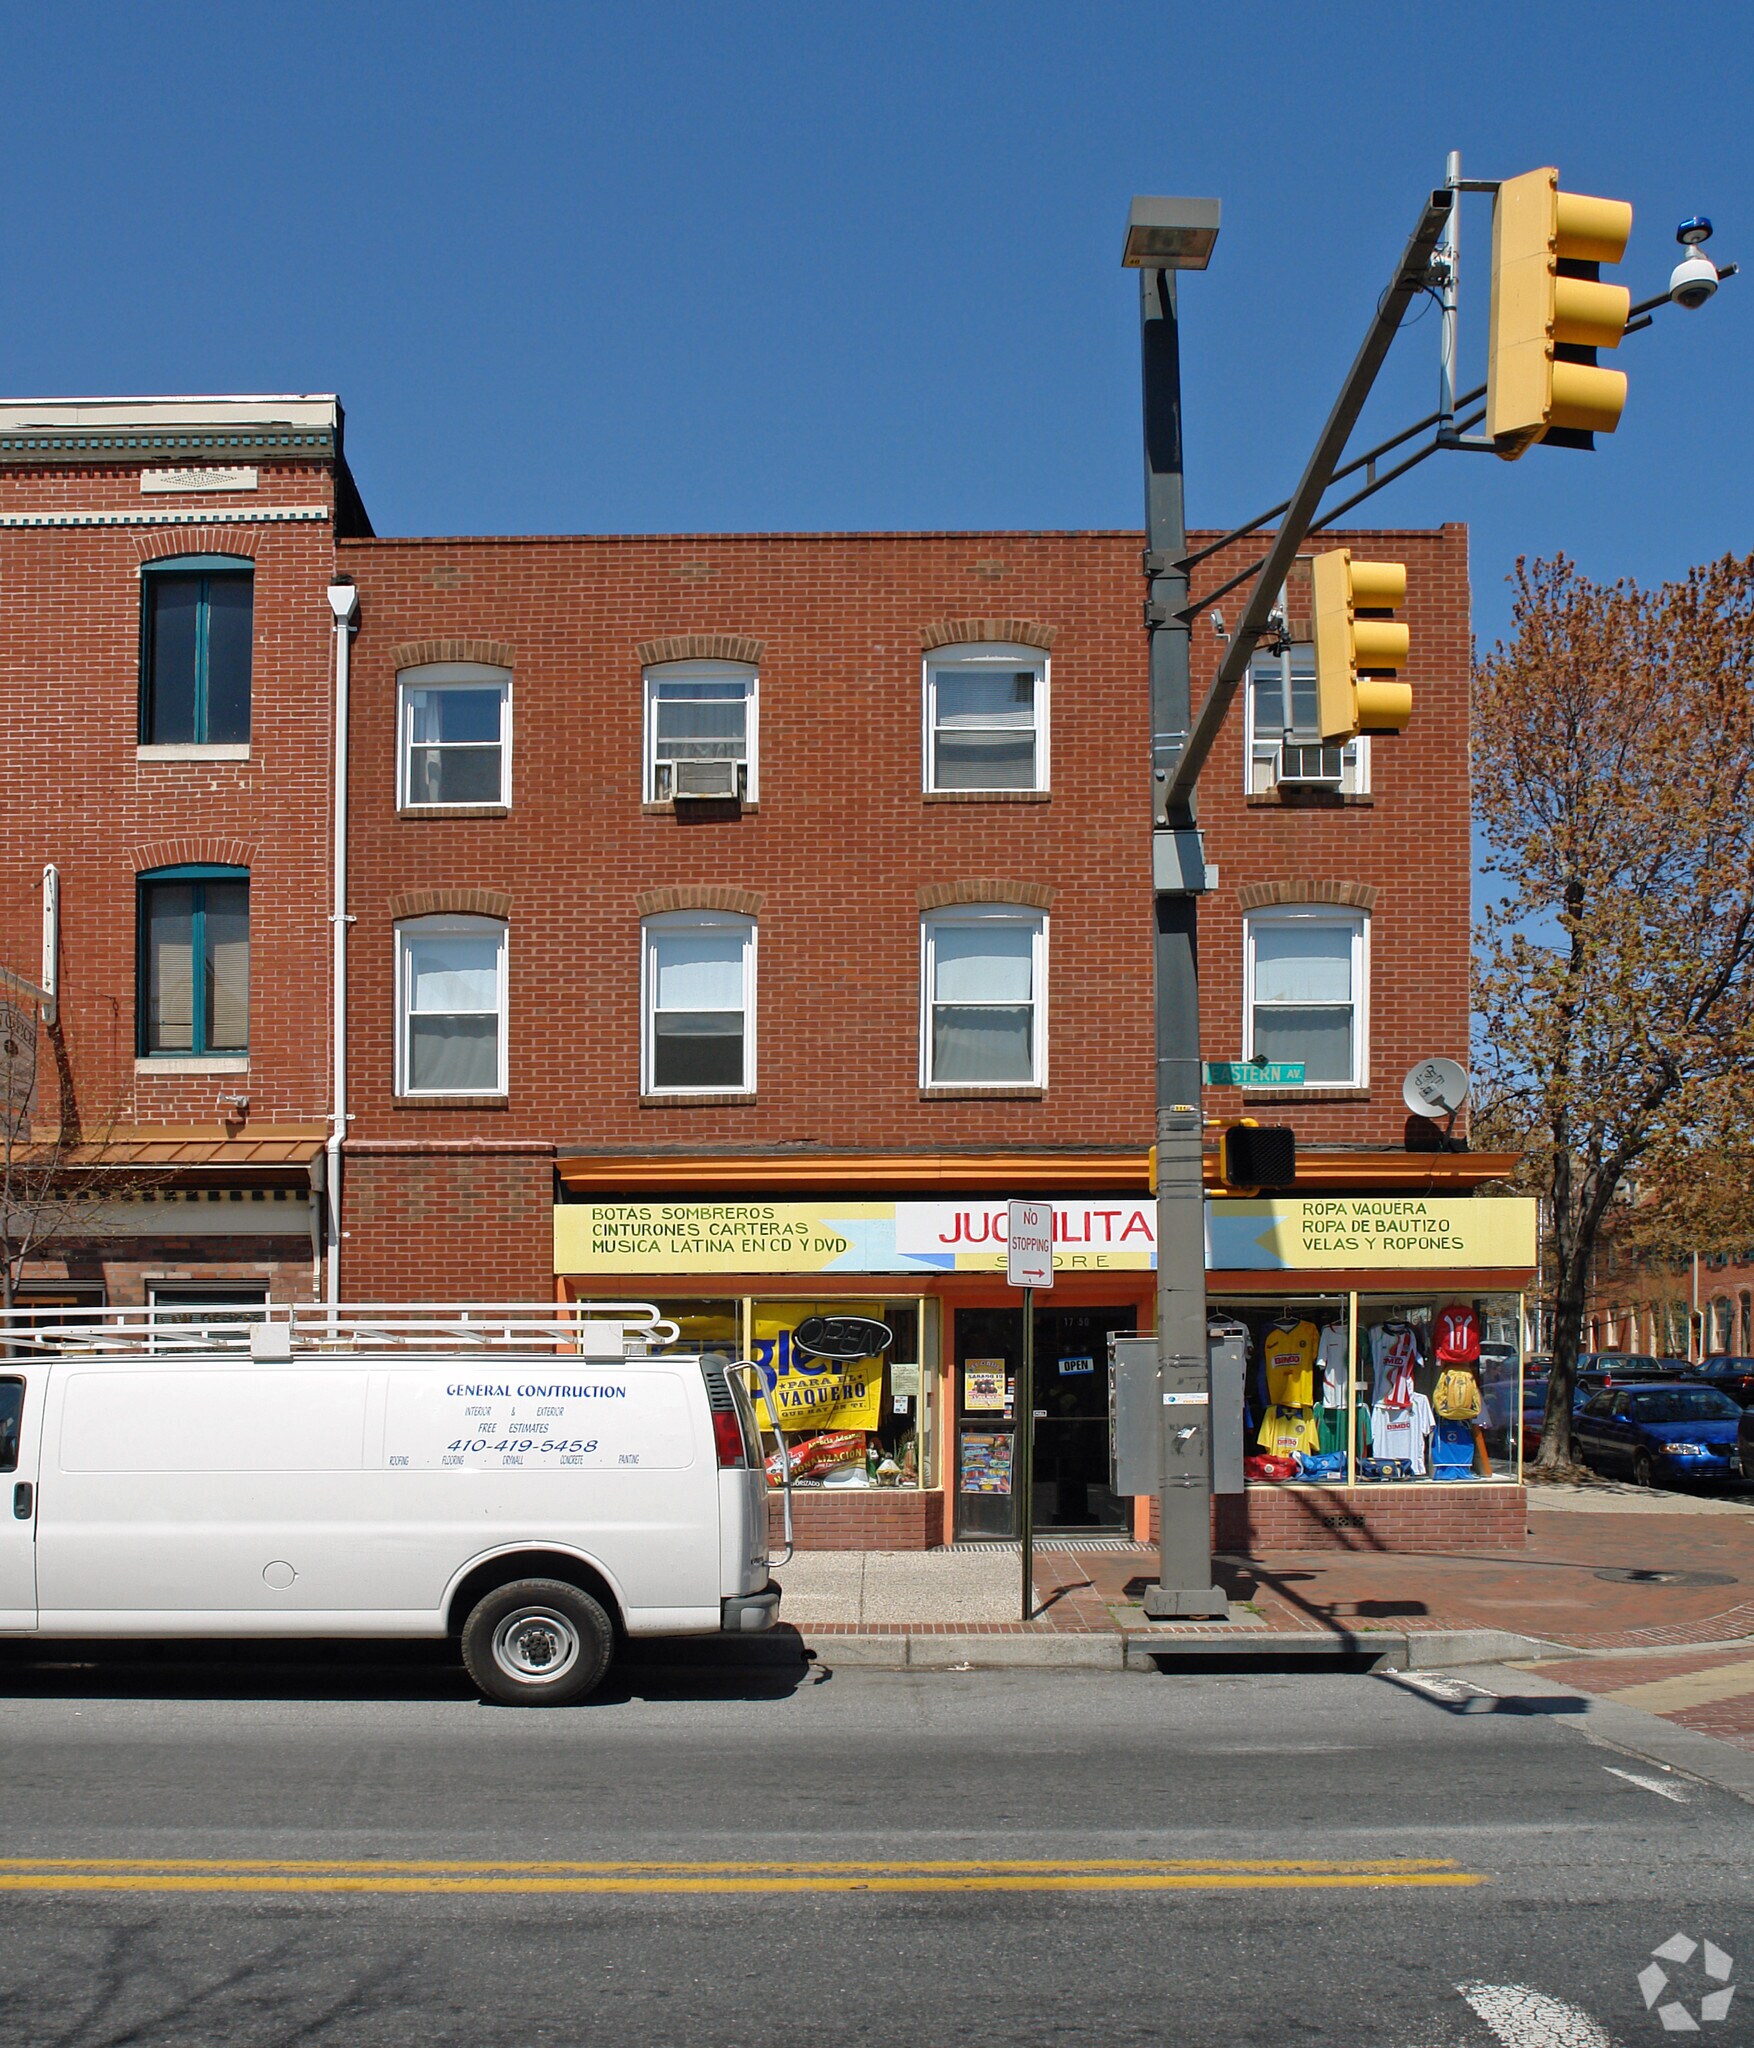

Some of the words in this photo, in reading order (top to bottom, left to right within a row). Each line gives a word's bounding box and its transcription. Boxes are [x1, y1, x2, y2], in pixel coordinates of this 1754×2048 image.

[1213, 1065, 1280, 1082] EASTERN
[592, 1207, 652, 1220] BOTAS
[661, 1207, 775, 1220] SOMBREROS
[1302, 1203, 1348, 1216] ROPA
[1352, 1202, 1427, 1215] VAQUERA
[1023, 1211, 1039, 1226] NO
[592, 1223, 701, 1237] CINTURONES
[709, 1222, 809, 1236] CARTERAS
[938, 1210, 1155, 1244] JUILITA
[1302, 1220, 1347, 1234] ROPA
[1351, 1220, 1371, 1233] DE
[1375, 1219, 1451, 1233] BAUTIZO
[592, 1240, 662, 1253] MUSICA
[671, 1239, 735, 1253] LATINA
[742, 1239, 765, 1253] EN
[770, 1238, 792, 1252] CD
[799, 1239, 809, 1252] Y
[814, 1238, 847, 1253] DVD
[1012, 1236, 1049, 1253] STOPPING
[1302, 1238, 1359, 1251] VELAS
[1365, 1237, 1377, 1250] Y
[1383, 1237, 1464, 1250] ROPONES
[994, 1255, 1110, 1268] SORE
[1064, 1360, 1089, 1372] OPEN
[787, 1377, 832, 1389] PARA
[837, 1374, 857, 1384] EL
[447, 1384, 512, 1397] GENERAL
[517, 1385, 627, 1399] CONSTRUCTION
[780, 1382, 866, 1408] VAQUERO
[465, 1406, 492, 1417] INTERIOR
[511, 1406, 516, 1416] &
[536, 1406, 565, 1417] EXTERIOR
[781, 1410, 804, 1418] QUE
[808, 1406, 829, 1414] HAY
[478, 1423, 498, 1434] FREE
[508, 1423, 550, 1434] ESTIMATES
[447, 1439, 599, 1452] 410-419-5458
[389, 1455, 410, 1466] ROOFING
[441, 1455, 465, 1466] FLOORING
[502, 1454, 524, 1465] DRYWALL
[559, 1454, 584, 1465] CONCRETE
[618, 1454, 640, 1465] PAINTING
